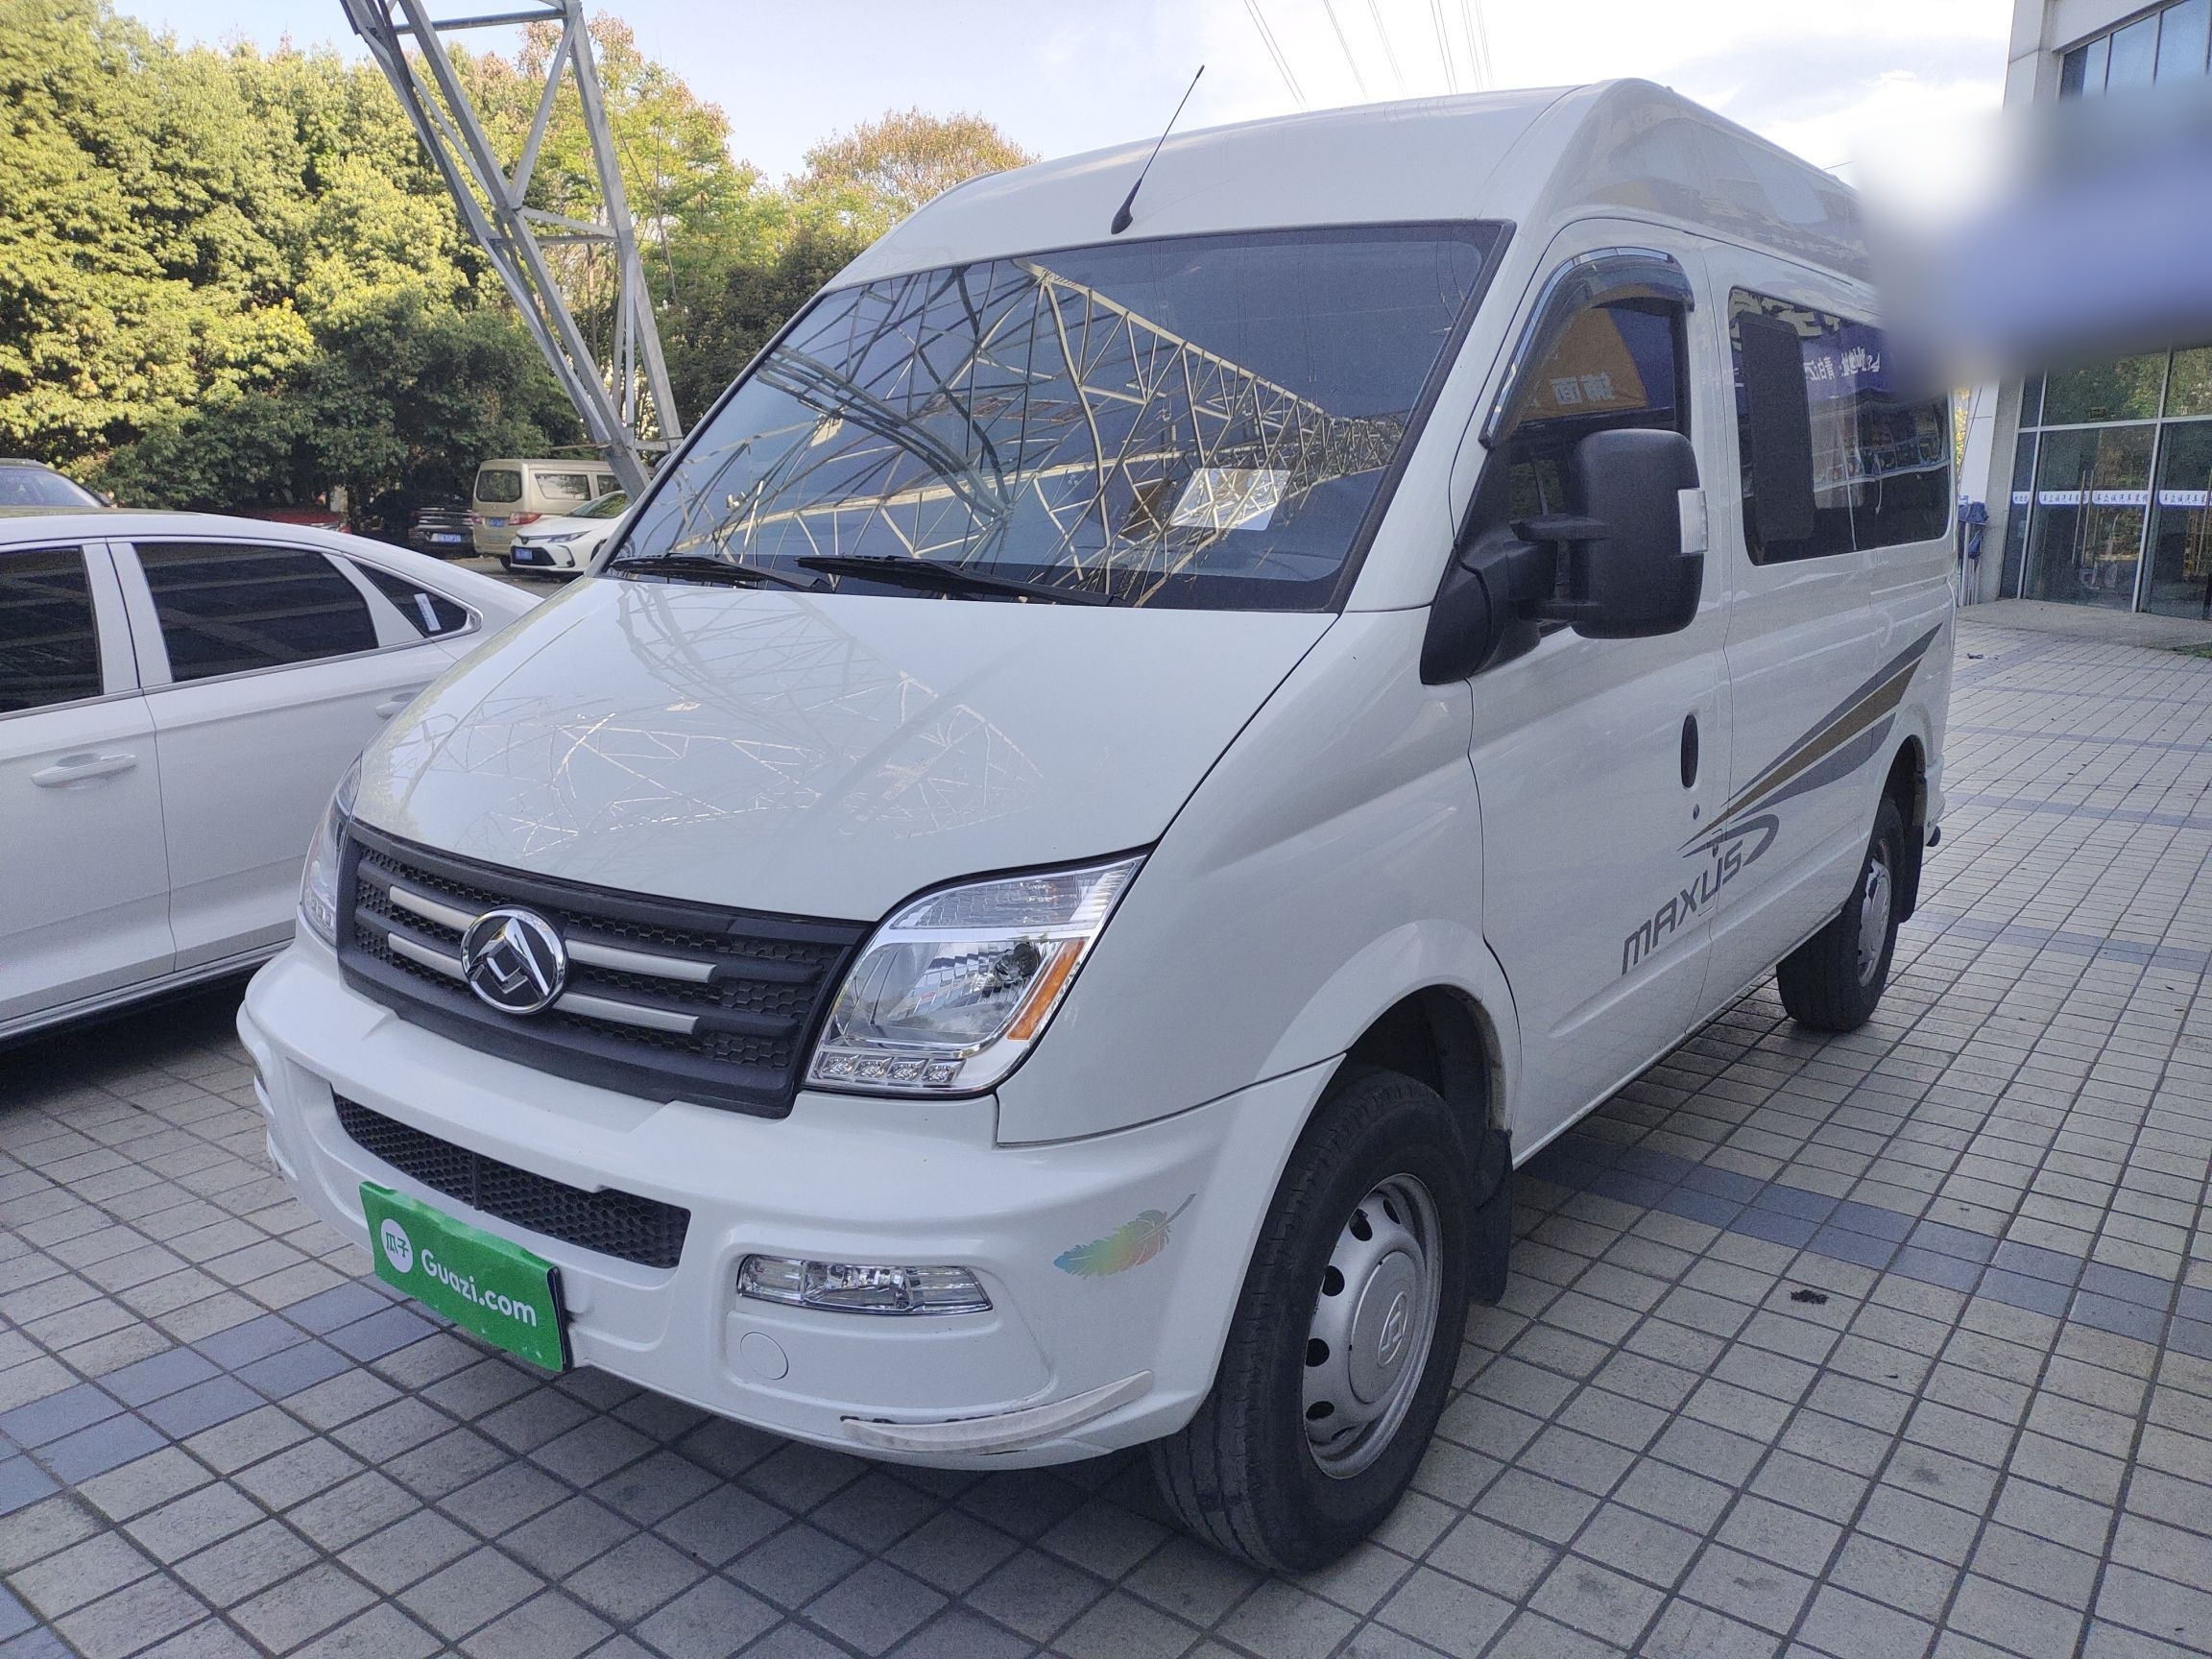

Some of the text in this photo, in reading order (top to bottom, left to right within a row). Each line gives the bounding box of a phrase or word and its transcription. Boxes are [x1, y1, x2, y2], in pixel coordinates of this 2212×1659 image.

[1622, 839, 1743, 975] MAXUS
[385, 1231, 409, 1259] 瓜子
[421, 1249, 537, 1327] Guazi.com
